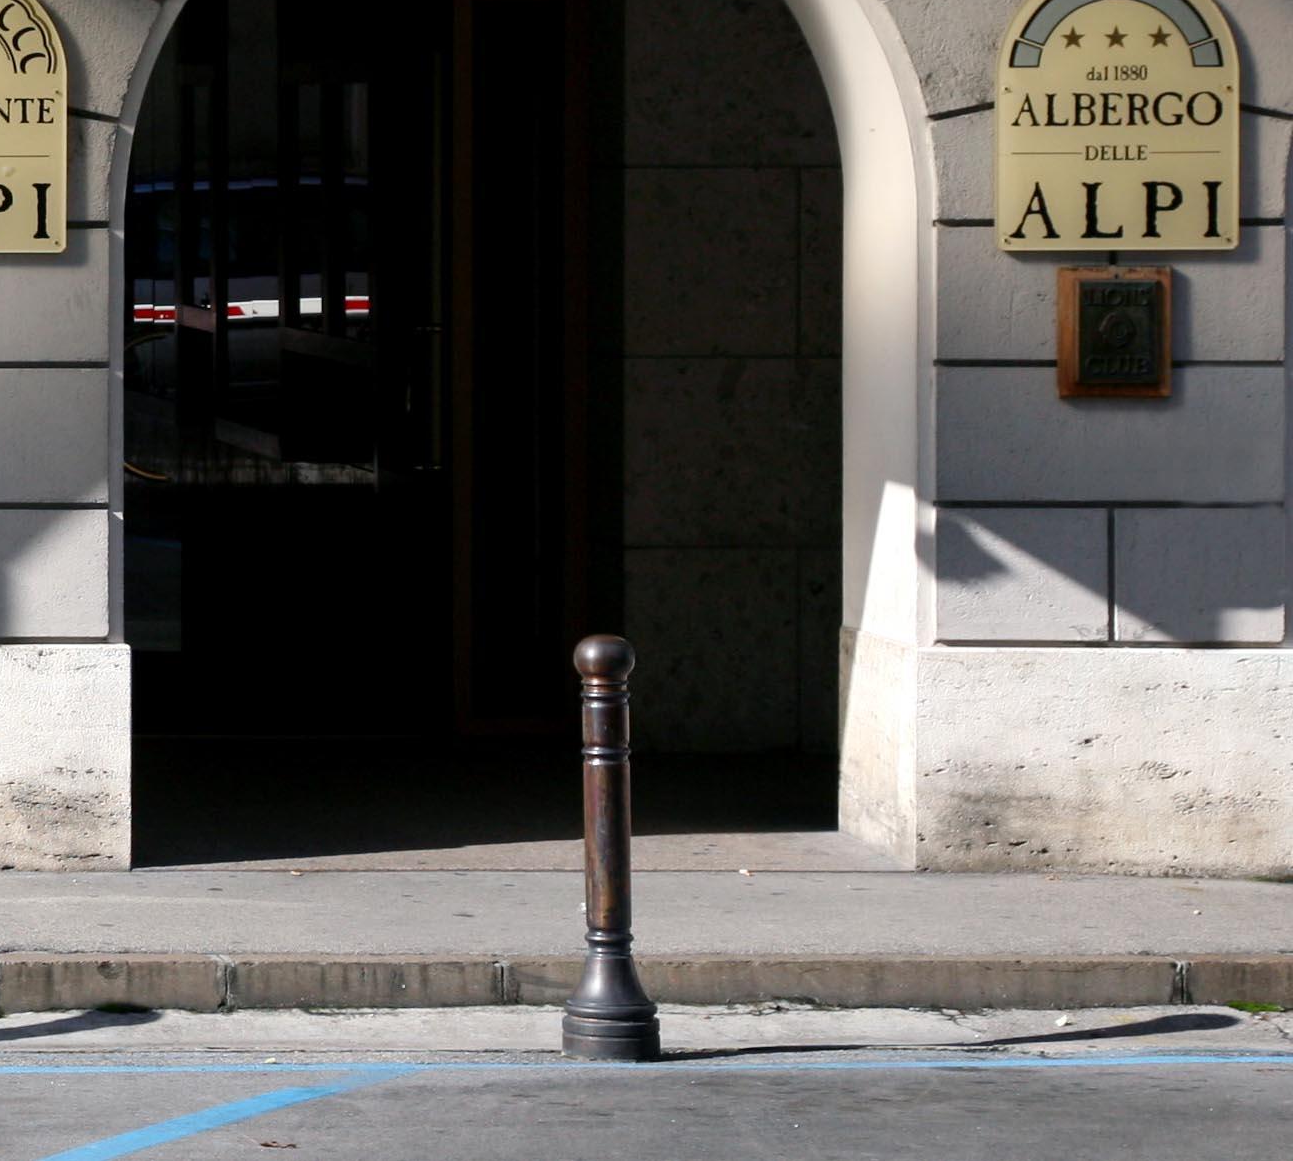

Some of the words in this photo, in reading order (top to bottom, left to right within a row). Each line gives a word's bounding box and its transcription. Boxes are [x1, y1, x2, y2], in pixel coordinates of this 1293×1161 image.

[1086, 65, 1109, 82] dal
[1113, 64, 1148, 81] 1880
[1010, 90, 1224, 127] ALBERGO
[1084, 144, 1148, 161] DELLE
[1009, 180, 1223, 240] ALPI
